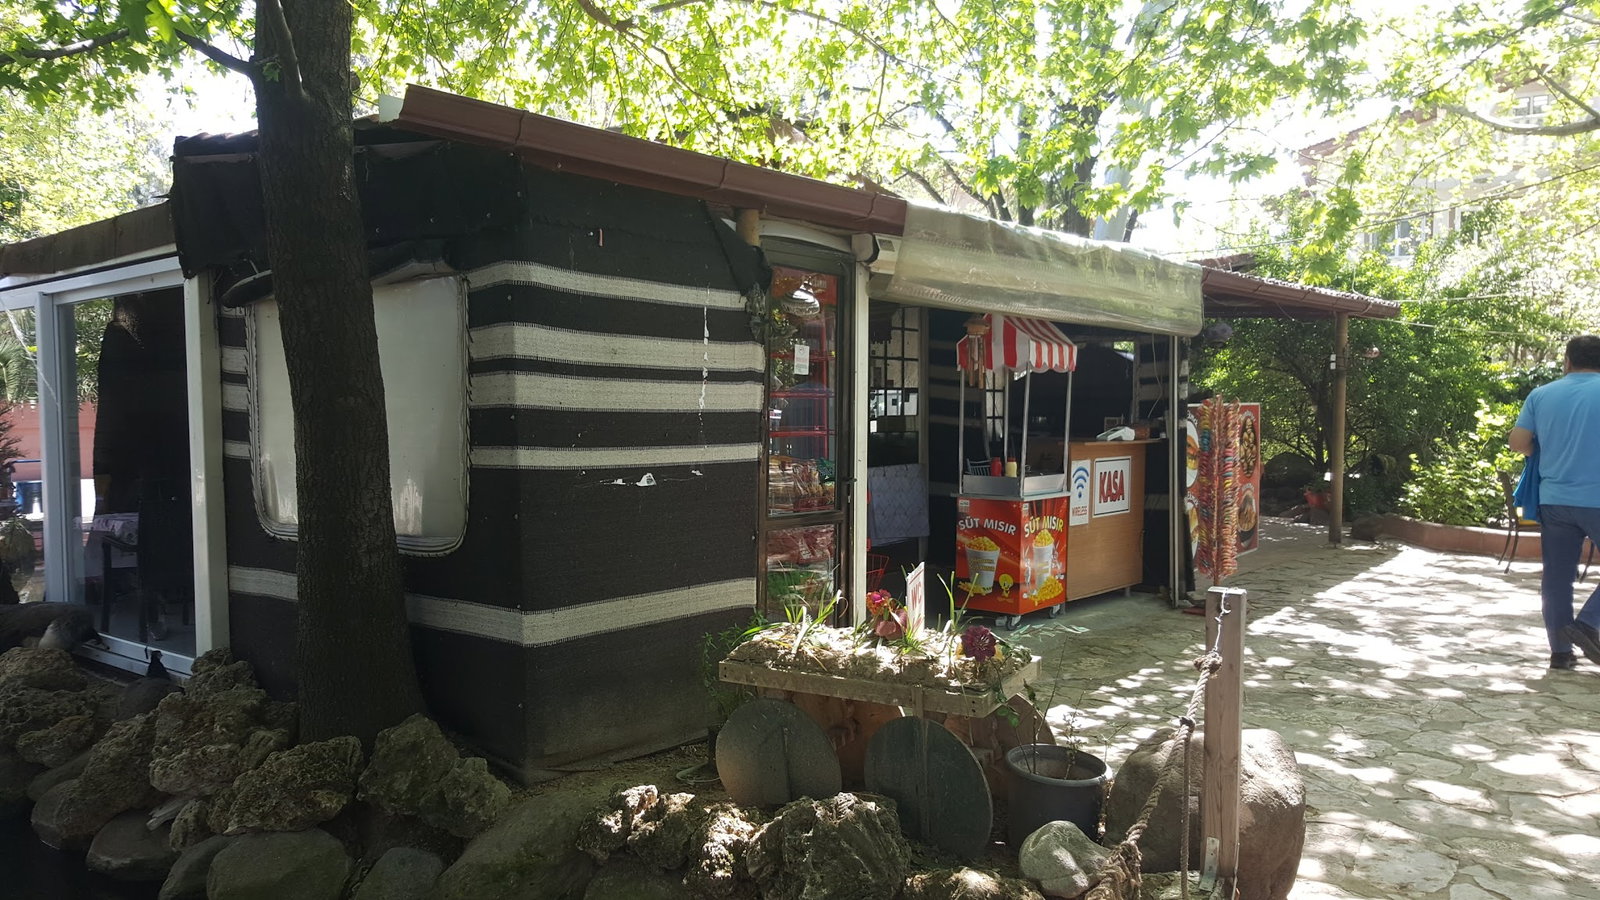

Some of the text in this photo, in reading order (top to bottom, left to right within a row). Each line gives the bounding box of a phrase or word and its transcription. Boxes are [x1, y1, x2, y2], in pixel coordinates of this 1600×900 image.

[1099, 469, 1125, 503] KASA
[958, 516, 1016, 535] SÜT MISIR
[1024, 515, 1064, 537] SÜT MISIR
[911, 582, 922, 609] WC
